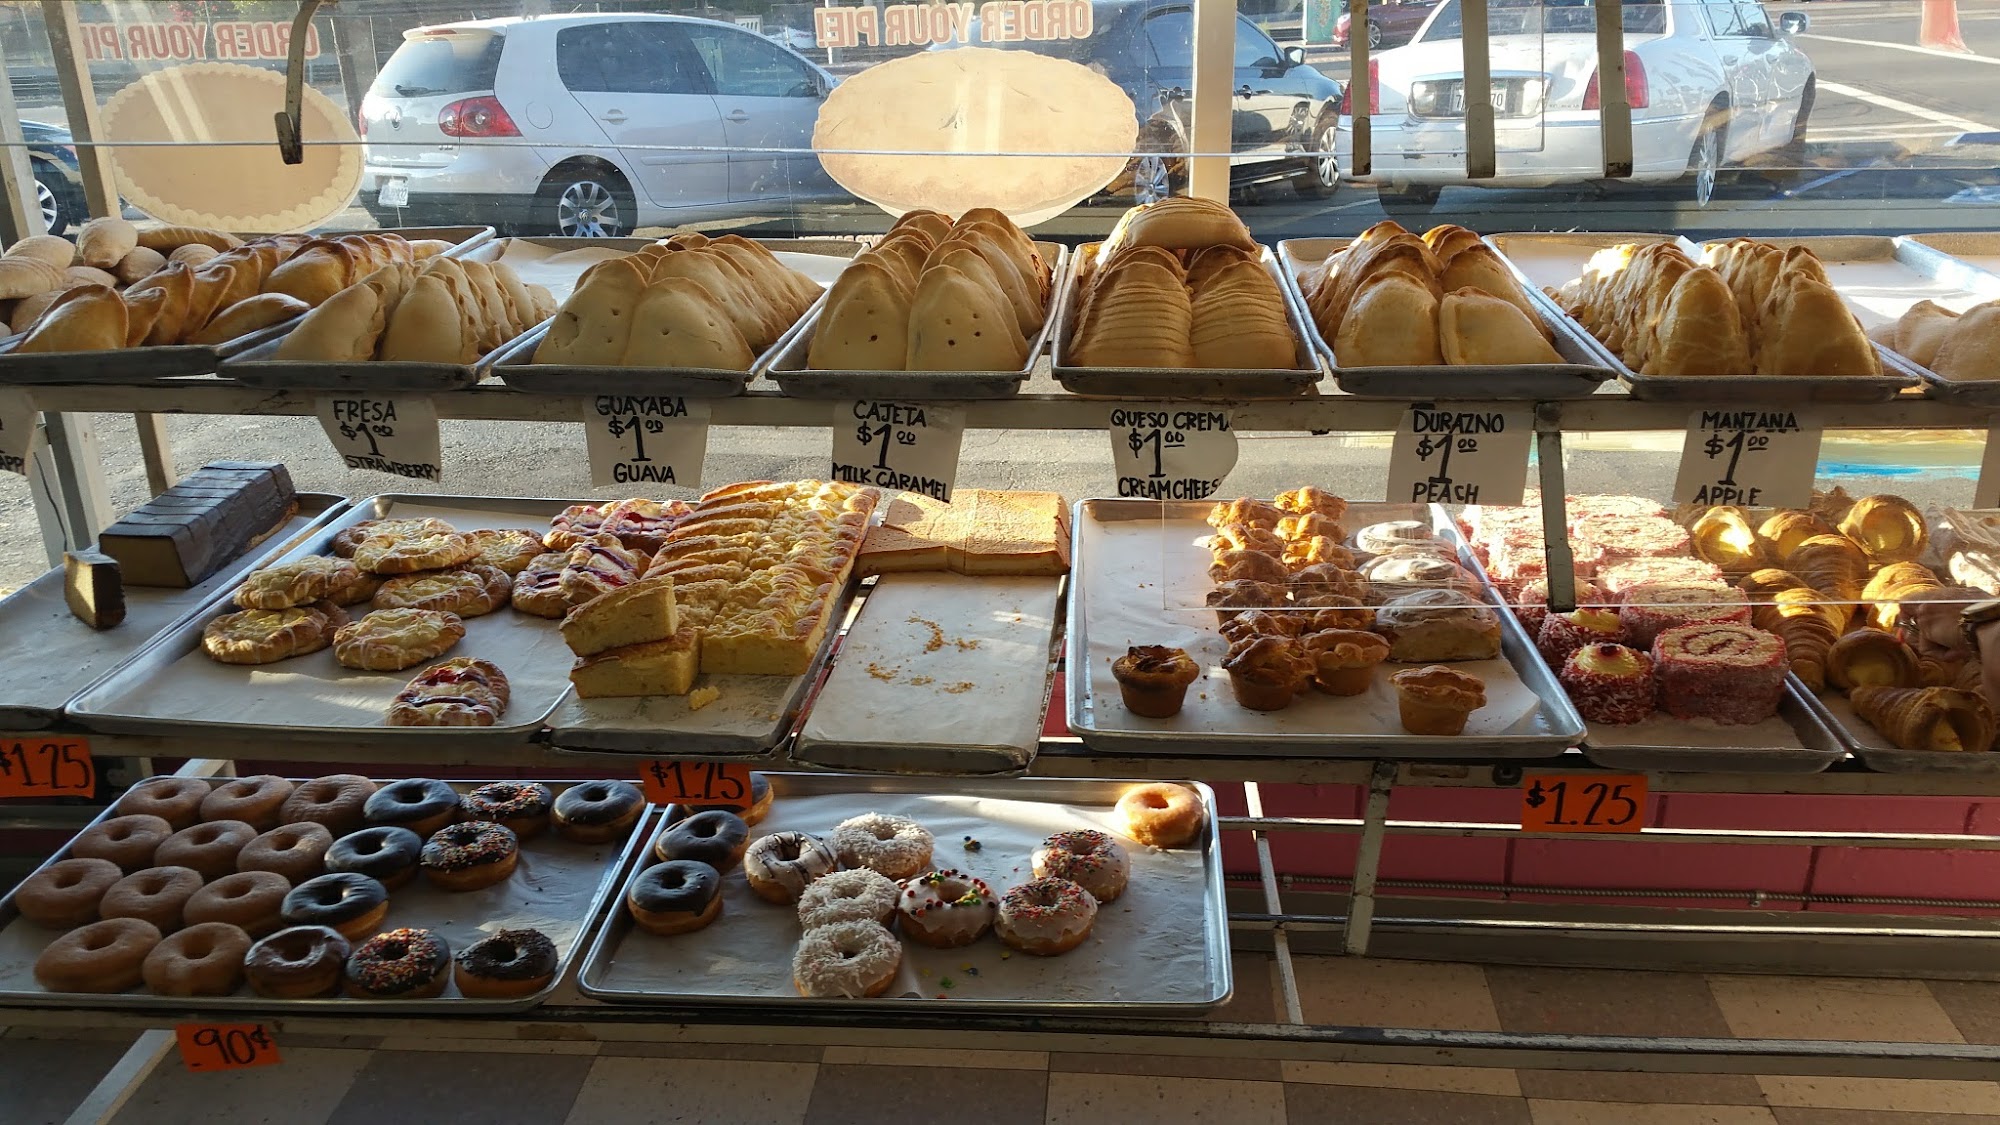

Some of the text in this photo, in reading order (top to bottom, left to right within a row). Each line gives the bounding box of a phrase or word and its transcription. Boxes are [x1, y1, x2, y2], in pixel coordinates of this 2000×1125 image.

[333, 400, 397, 422] FRESA
[595, 395, 687, 417] GUAYABA
[853, 400, 927, 427] CAJETA
[1111, 409, 1169, 428] QUESO
[1413, 410, 1504, 434] DURAZNO
[1701, 411, 1800, 433] MANZANA
[345, 455, 440, 482] STRAWBERRY
[613, 463, 676, 484] GUAVA
[832, 462, 950, 504] MILK CARAMEL
[1412, 482, 1479, 504] PEACH
[1692, 485, 1762, 506] APPLE
[1525, 780, 1637, 826] $1.25
